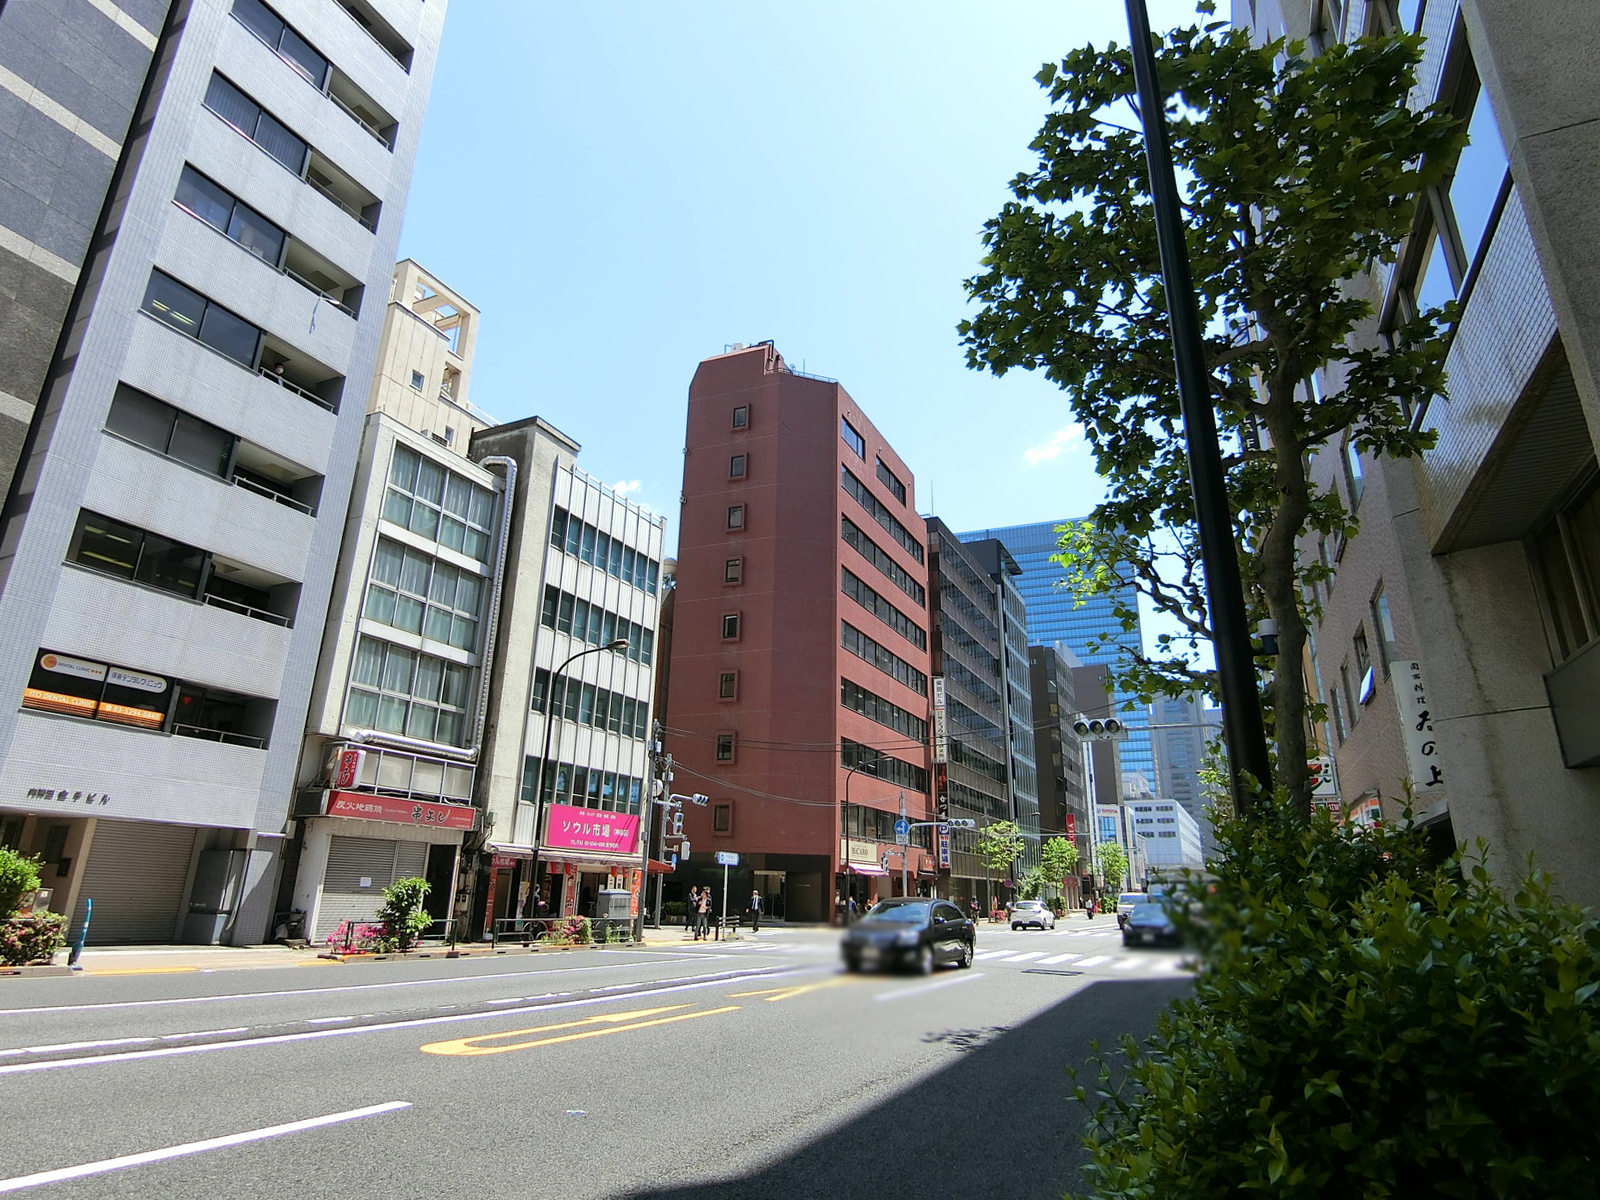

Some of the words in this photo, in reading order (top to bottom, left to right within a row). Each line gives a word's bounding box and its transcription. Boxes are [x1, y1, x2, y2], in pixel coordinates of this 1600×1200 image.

[58, 661, 75, 670] DENTAL
[75, 665, 91, 673] CLINIC
[43, 692, 71, 704] DENTAL
[71, 697, 94, 707] CLINIC
[562, 820, 610, 838] ソウル市場
[941, 840, 949, 862] 駐車場
